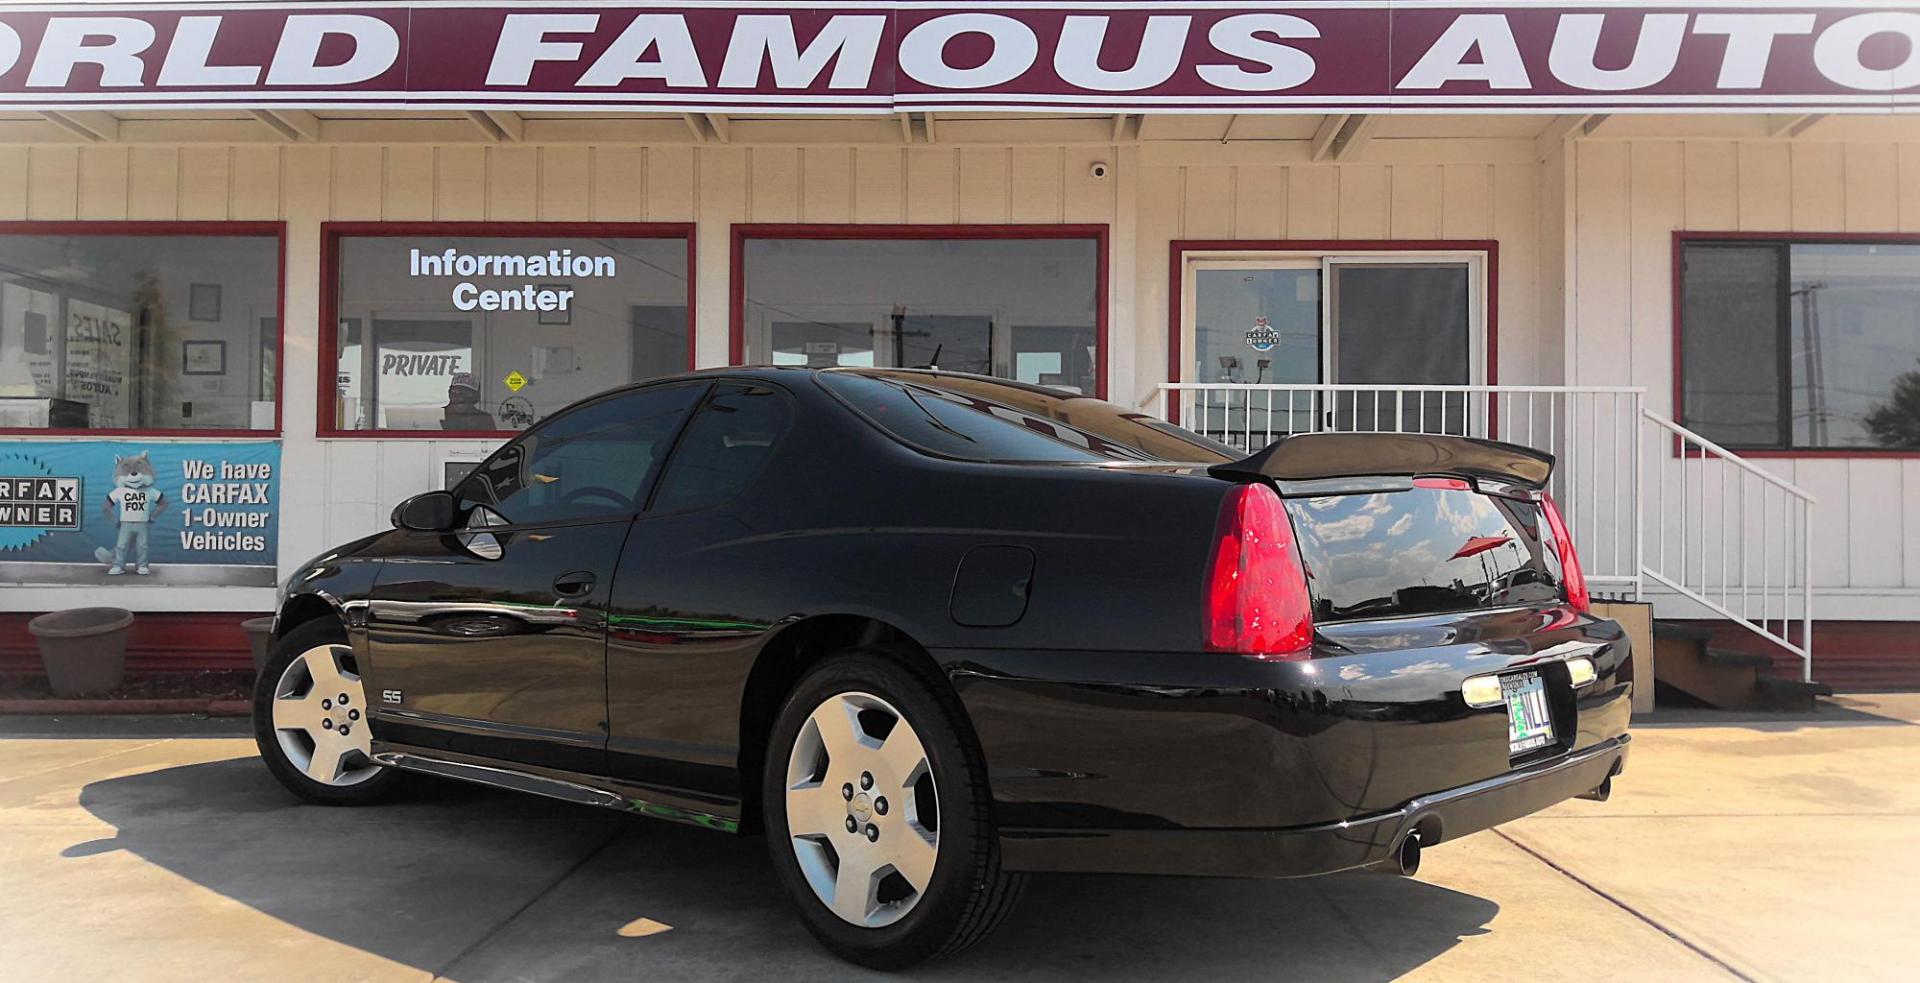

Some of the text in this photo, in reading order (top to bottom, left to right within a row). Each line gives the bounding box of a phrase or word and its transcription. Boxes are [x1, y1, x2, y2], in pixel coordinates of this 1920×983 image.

[0, 12, 1920, 91] RLD FAMOUS AUTO
[411, 248, 615, 277] Information
[452, 282, 574, 311] Center
[382, 353, 462, 377] PRIVATE
[183, 460, 271, 479] We have
[124, 493, 146, 501] CAR
[182, 484, 269, 504] CARFAX
[125, 502, 145, 511] FOX
[182, 508, 269, 528] 1-Owner
[180, 532, 265, 551] Vehicles
[383, 689, 402, 703] SS
